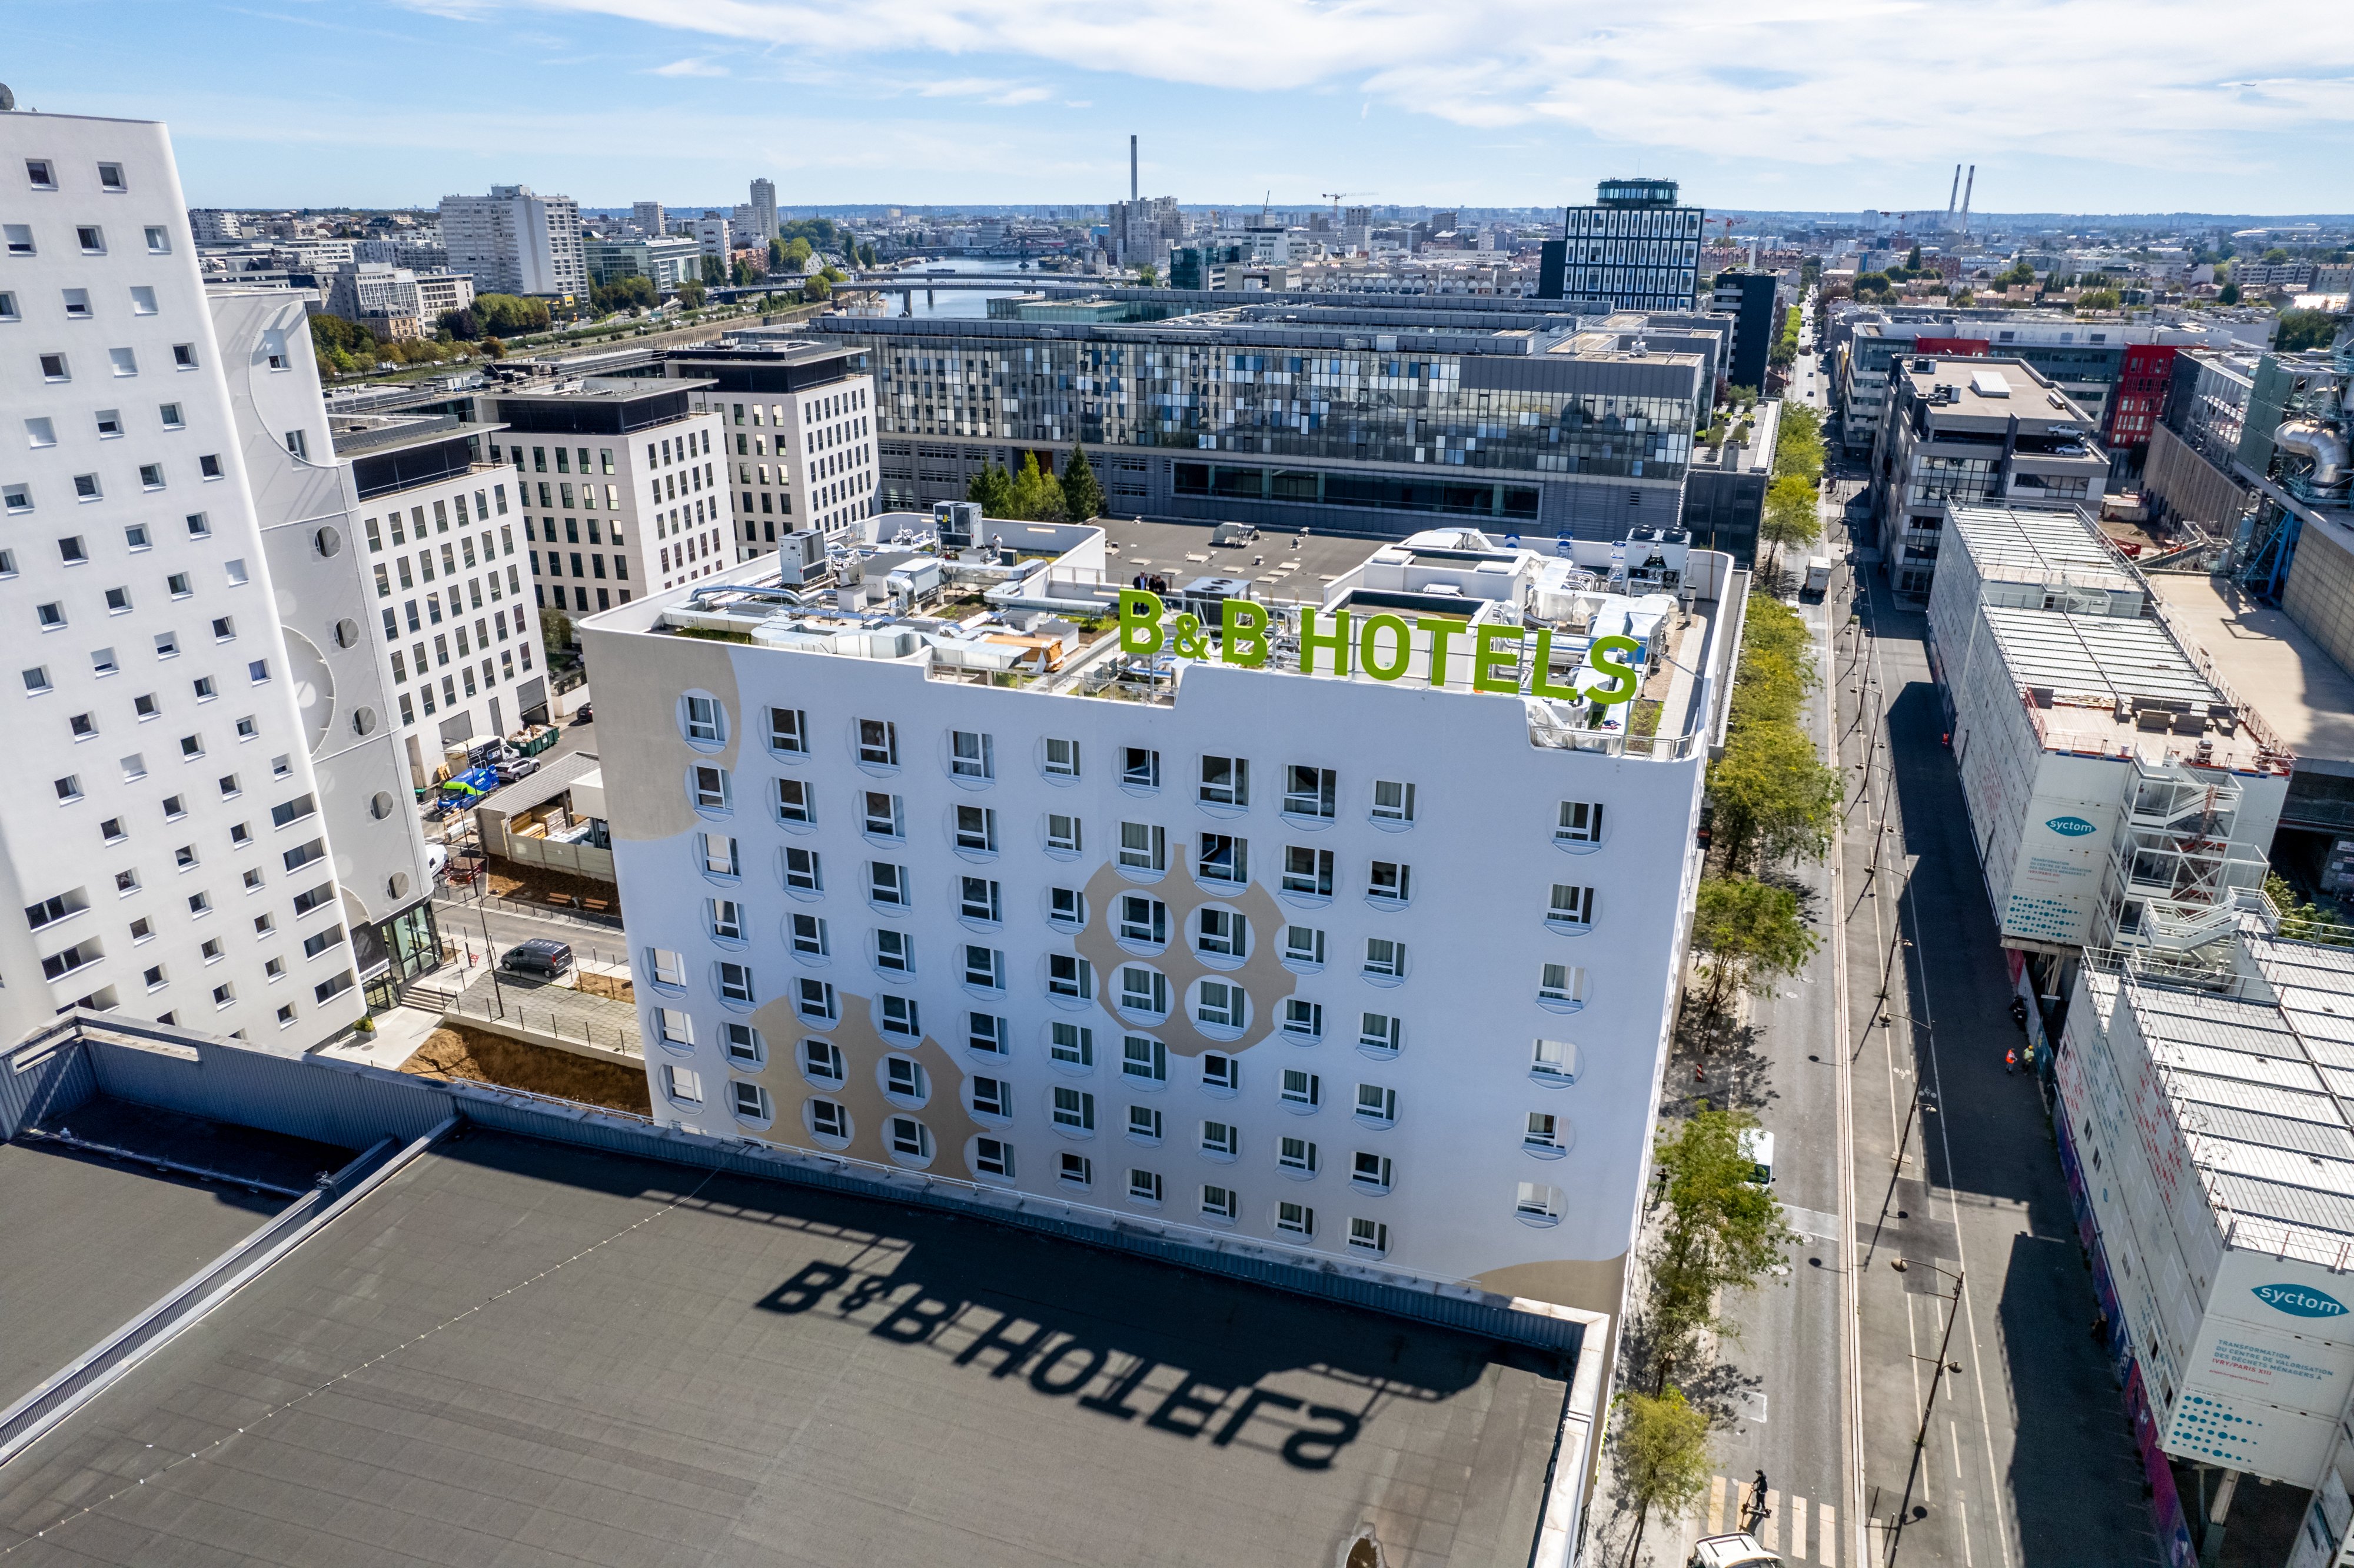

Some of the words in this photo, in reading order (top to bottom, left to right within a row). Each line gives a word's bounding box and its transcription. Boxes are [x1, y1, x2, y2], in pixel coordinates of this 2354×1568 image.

[1119, 589, 1269, 667] B&B
[1300, 606, 1641, 705] HOTELS
[2050, 821, 2092, 833] syctom
[2032, 857, 2069, 865] TRANSFORMATION
[366, 963, 388, 978] estudines
[2260, 1287, 2340, 1314] syctom
[2218, 1339, 2290, 1359] TRANSFORMATION
[2212, 1358, 2256, 1372] IVRY/PARIS
[2229, 1349, 2260, 1360] CENTRE
[2276, 1360, 2333, 1376] VALORISATION
[2232, 1355, 2267, 1368] DÉCHETS
[2270, 1364, 2314, 1379] MÉNAGERS
